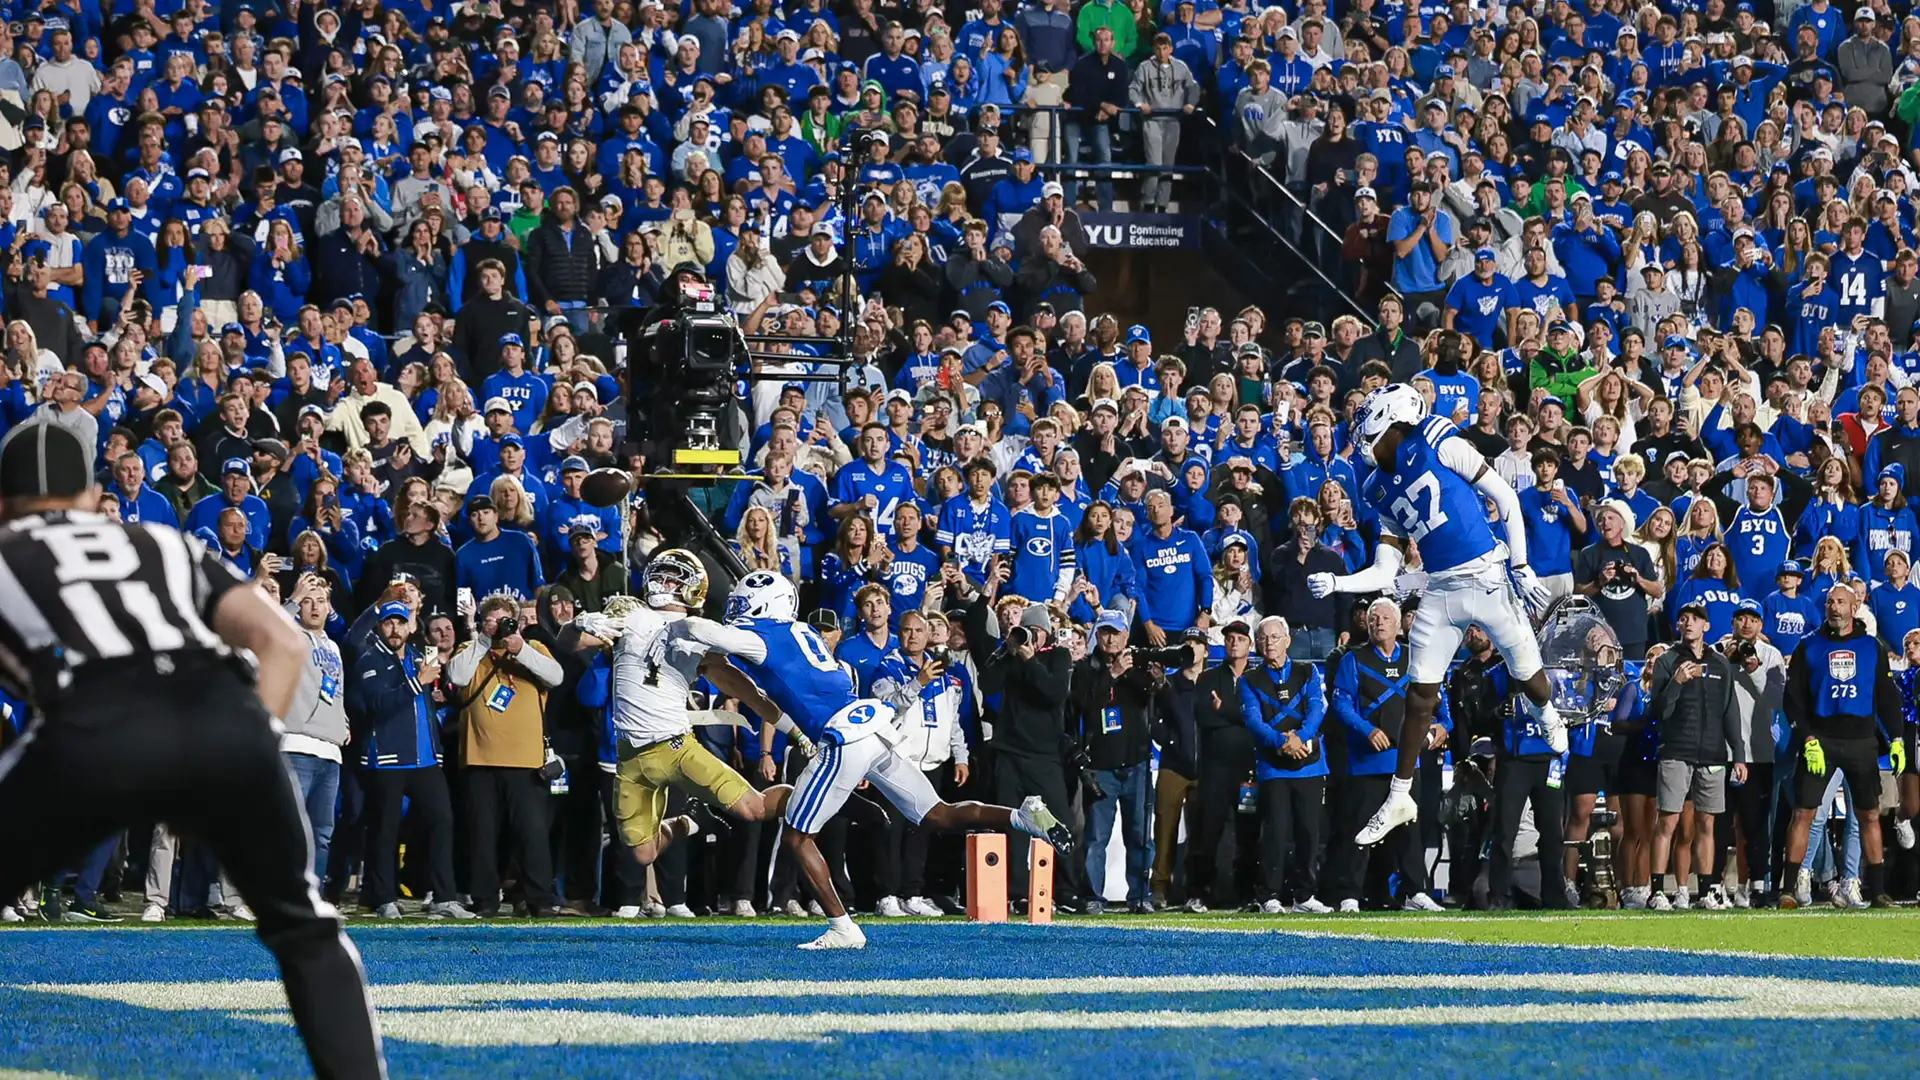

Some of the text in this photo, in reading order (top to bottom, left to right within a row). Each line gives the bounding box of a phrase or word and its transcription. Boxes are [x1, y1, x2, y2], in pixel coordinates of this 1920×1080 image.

[1083, 224, 1123, 246] YU
[1129, 224, 1184, 237] Continuing
[1129, 235, 1180, 247] Education
[1840, 273, 1867, 306] 14
[502, 386, 531, 400] BYU
[1439, 384, 1466, 396] BYU
[509, 400, 523, 411] Y
[1390, 470, 1449, 545] 27
[1739, 518, 1778, 535] BYU
[30, 522, 142, 583] B
[1750, 534, 1765, 556] 3
[1146, 553, 1191, 568] COUGARS
[1157, 547, 1178, 559] BYU
[1832, 683, 1857, 699] 273
